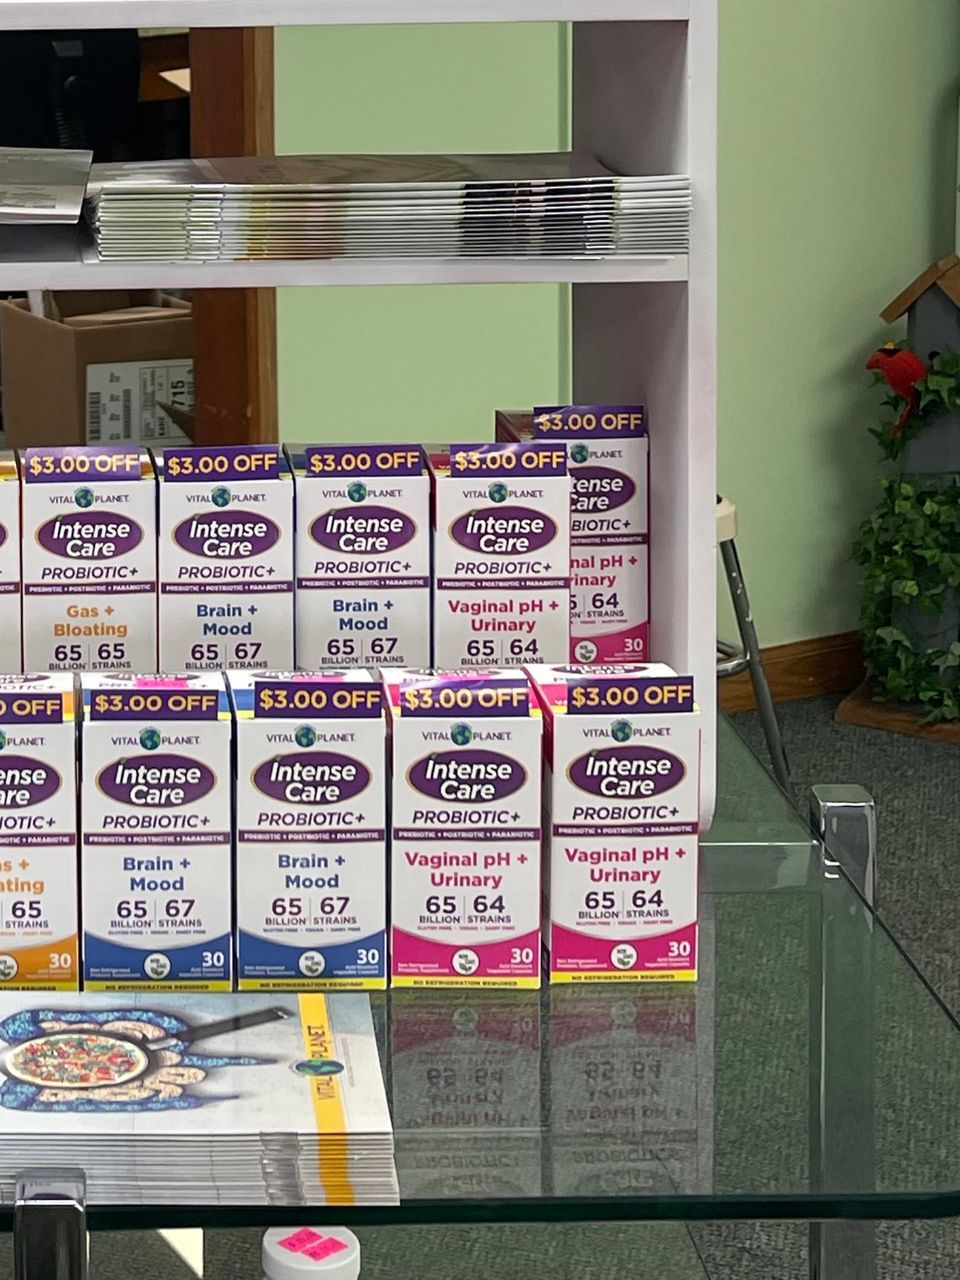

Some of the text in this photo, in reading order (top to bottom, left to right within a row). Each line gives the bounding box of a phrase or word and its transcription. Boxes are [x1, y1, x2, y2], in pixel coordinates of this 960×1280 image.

[538, 413, 642, 432] $3.00 OFF
[591, 592, 620, 609] 64
[196, 604, 241, 617] Brain
[586, 610, 624, 618] STRAINS
[203, 622, 252, 636] Mood
[471, 618, 536, 634] Urinary
[94, 695, 216, 717] $3.00 OFF
[123, 856, 174, 872] Brain
[404, 851, 513, 869] Vaginal pH
[130, 876, 185, 892] Mood
[430, 872, 503, 889] Urinary
[116, 899, 196, 919] 65 67
[307, 1023, 328, 1059] PLANET
